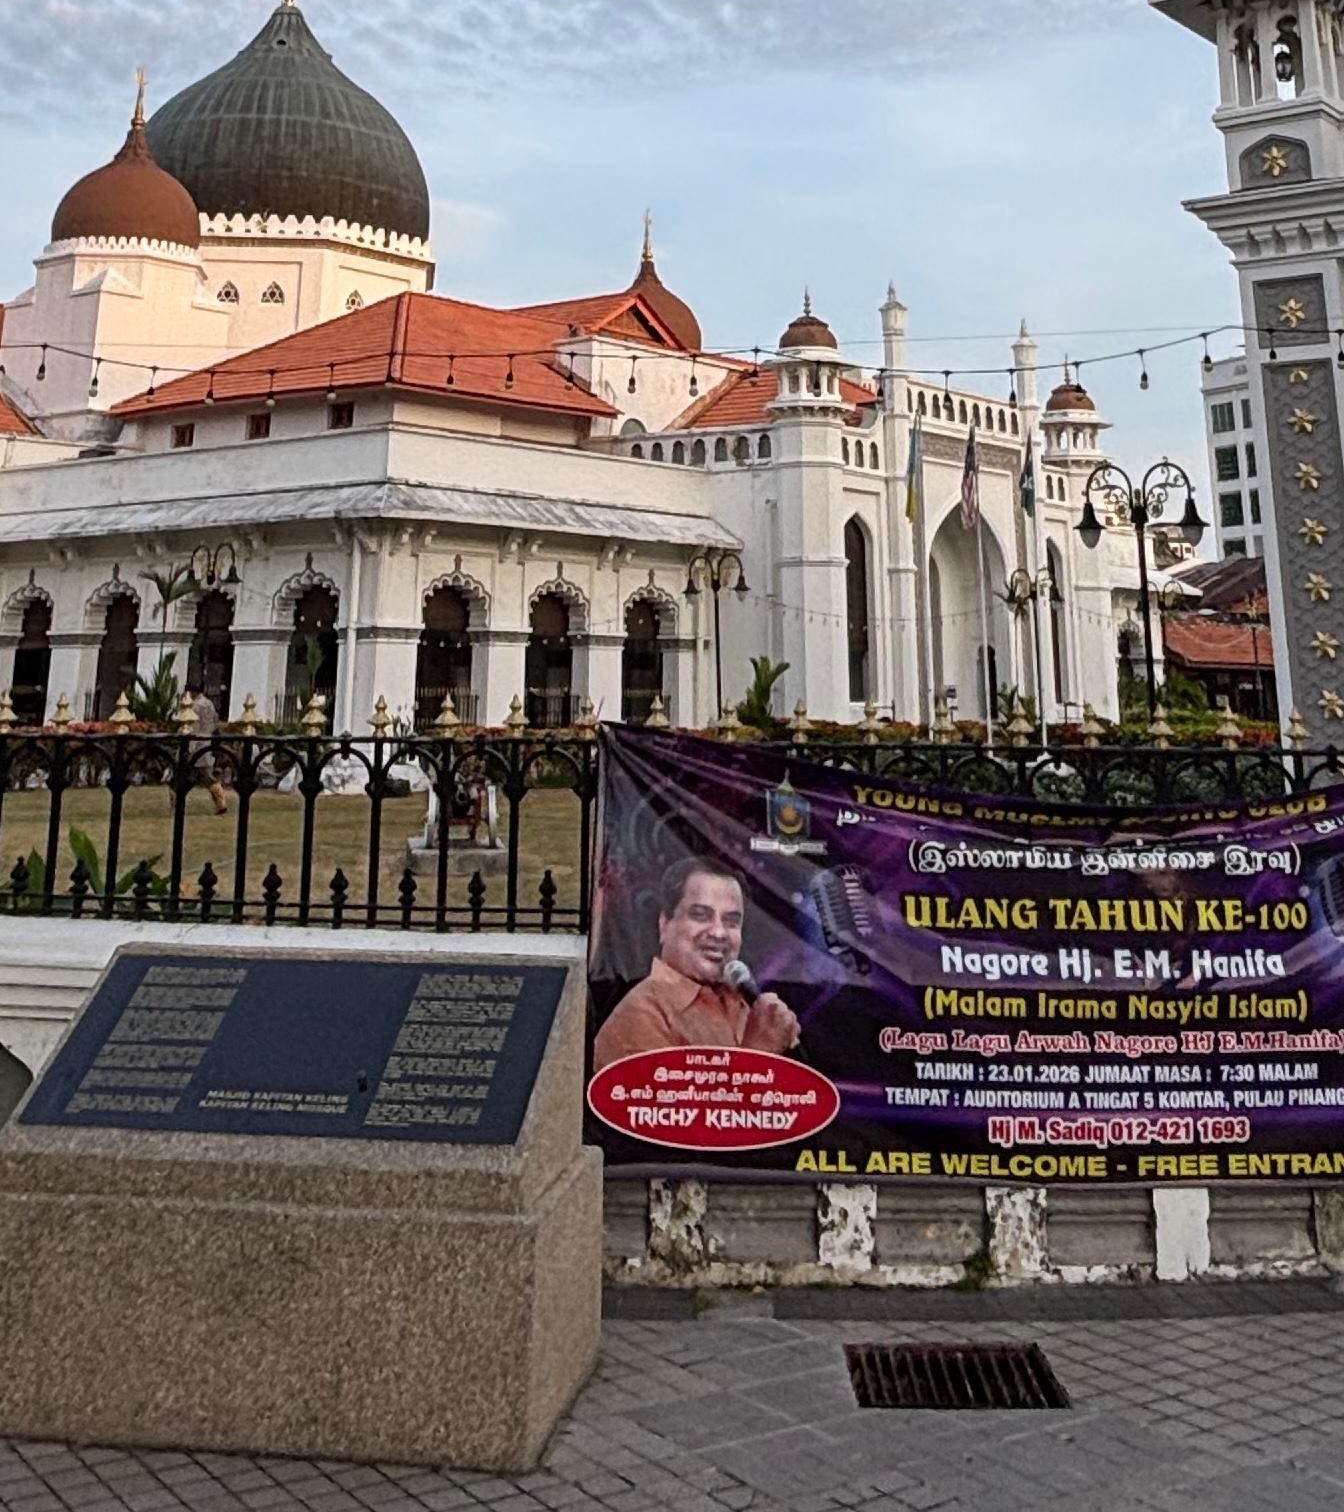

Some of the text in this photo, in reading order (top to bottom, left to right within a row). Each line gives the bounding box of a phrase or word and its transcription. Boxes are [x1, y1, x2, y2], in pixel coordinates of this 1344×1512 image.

[854, 785, 963, 817] YOUNG
[908, 838, 1074, 874] (இஸ்லாமிய
[1223, 841, 1301, 876] இரவு)
[904, 894, 1308, 931] ULANG TAHUN KE-100
[941, 945, 1286, 984] Nagore Hj. E.M. Hanifa
[924, 986, 1308, 1025] (Malam Irama Nasyid Islam)
[880, 1027, 947, 1054] (Lagu
[951, 1029, 1010, 1056] Lagu
[1015, 1030, 1090, 1053] Arwah
[1094, 1031, 1177, 1057] Nagore
[1181, 1031, 1213, 1053] HJ
[915, 1061, 974, 1081] TARIKH
[988, 1063, 1081, 1083] 23.01.2026
[1084, 1064, 1150, 1084] JUMAAT
[1155, 1065, 1202, 1084] MASA
[1220, 1064, 1254, 1082] 7:30
[1258, 1062, 1319, 1081] MALAM
[885, 1087, 949, 1107] TEMPAT
[963, 1089, 1064, 1109] AUDITORIUM
[1068, 1090, 1080, 1109] A
[1084, 1090, 1140, 1110] TINGAT
[1143, 1091, 1154, 1110] 5
[1159, 1090, 1229, 1112] KOMTAR,
[1233, 1089, 1285, 1108] PULAU
[627, 1105, 798, 1130] TRICHY KENNEDY
[989, 1117, 1248, 1147] Hj M. Sadiq 012-421 1693
[795, 1150, 857, 1172] ALL
[865, 1152, 932, 1175] ARE
[940, 1152, 1107, 1177] WELCOME
[1138, 1154, 1220, 1177] FREE
